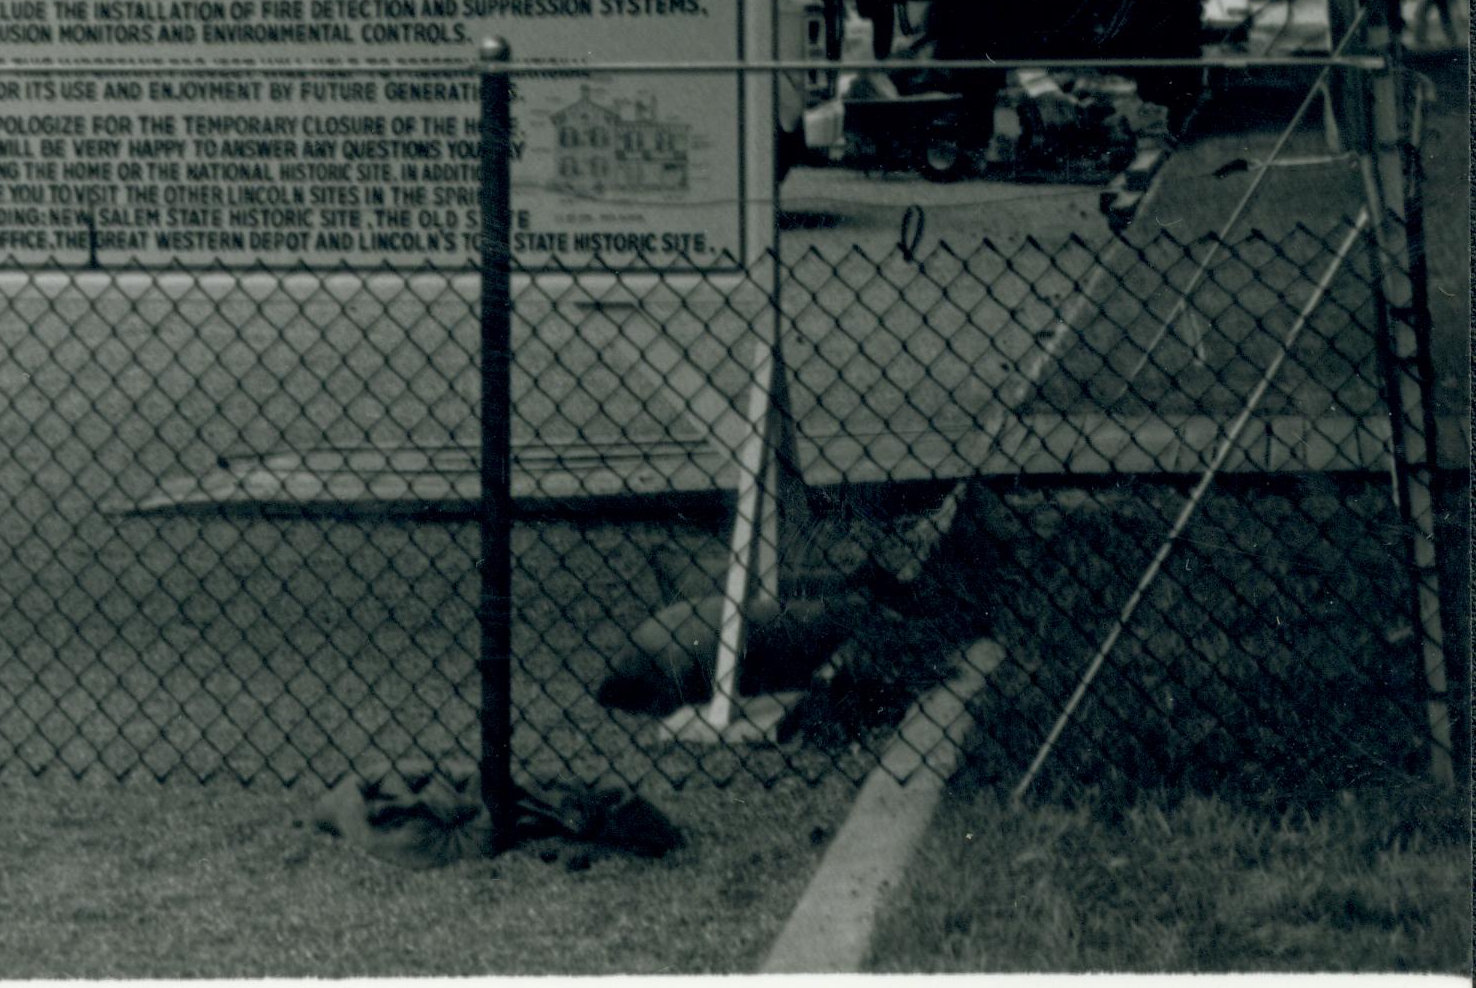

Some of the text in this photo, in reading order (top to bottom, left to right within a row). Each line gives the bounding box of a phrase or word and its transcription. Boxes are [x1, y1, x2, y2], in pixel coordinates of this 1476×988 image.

[54, 0, 89, 20] THE
[94, 0, 226, 20] INSTALLATION
[229, 0, 256, 19] OF
[261, 0, 304, 19] FIRE
[58, 24, 154, 44] MONITORS
[157, 24, 198, 44] AND
[202, 24, 354, 44] ENVIRONMENTAL
[360, 23, 472, 44] CONTROLS.
[60, 81, 97, 101] USE
[103, 81, 143, 101] AND
[148, 81, 263, 102] ENJOYMENT
[299, 81, 378, 102] FUTURE
[92, 115, 133, 135] FOR
[137, 115, 176, 135] THE
[184, 115, 299, 135] TEMPORARY
[301, 115, 386, 135] CLOSURE
[392, 115, 420, 135] OF
[422, 116, 458, 136] THE
[40, 139, 66, 158] BE
[72, 139, 122, 158] VERY
[127, 139, 187, 158] HAPPY
[220, 139, 297, 159] ANSWER
[341, 139, 440, 159] QUESTIONS
[23, 162, 56, 181] THE
[62, 162, 114, 181] HOME
[146, 162, 180, 181] THE
[186, 163, 274, 181] NATIONAL
[279, 163, 351, 182] HISTORIC
[8, 184, 45, 205] YOU
[124, 185, 159, 206] THE
[163, 185, 224, 206] OTHER
[228, 185, 305, 206] LINCOLN
[309, 186, 359, 207] SITES
[392, 186, 427, 207] THE
[99, 206, 161, 227] SALEM
[165, 207, 222, 228] STATE
[229, 207, 314, 228] HISTORIC
[418, 208, 458, 229] OLD
[154, 230, 244, 252] WESTERN
[249, 231, 309, 252] DEPOT
[315, 231, 354, 253] AND
[359, 231, 457, 253] LINCOLN'S
[514, 232, 568, 253] STATE
[574, 232, 657, 254] HISTORIC
[661, 232, 716, 254] SITE.
